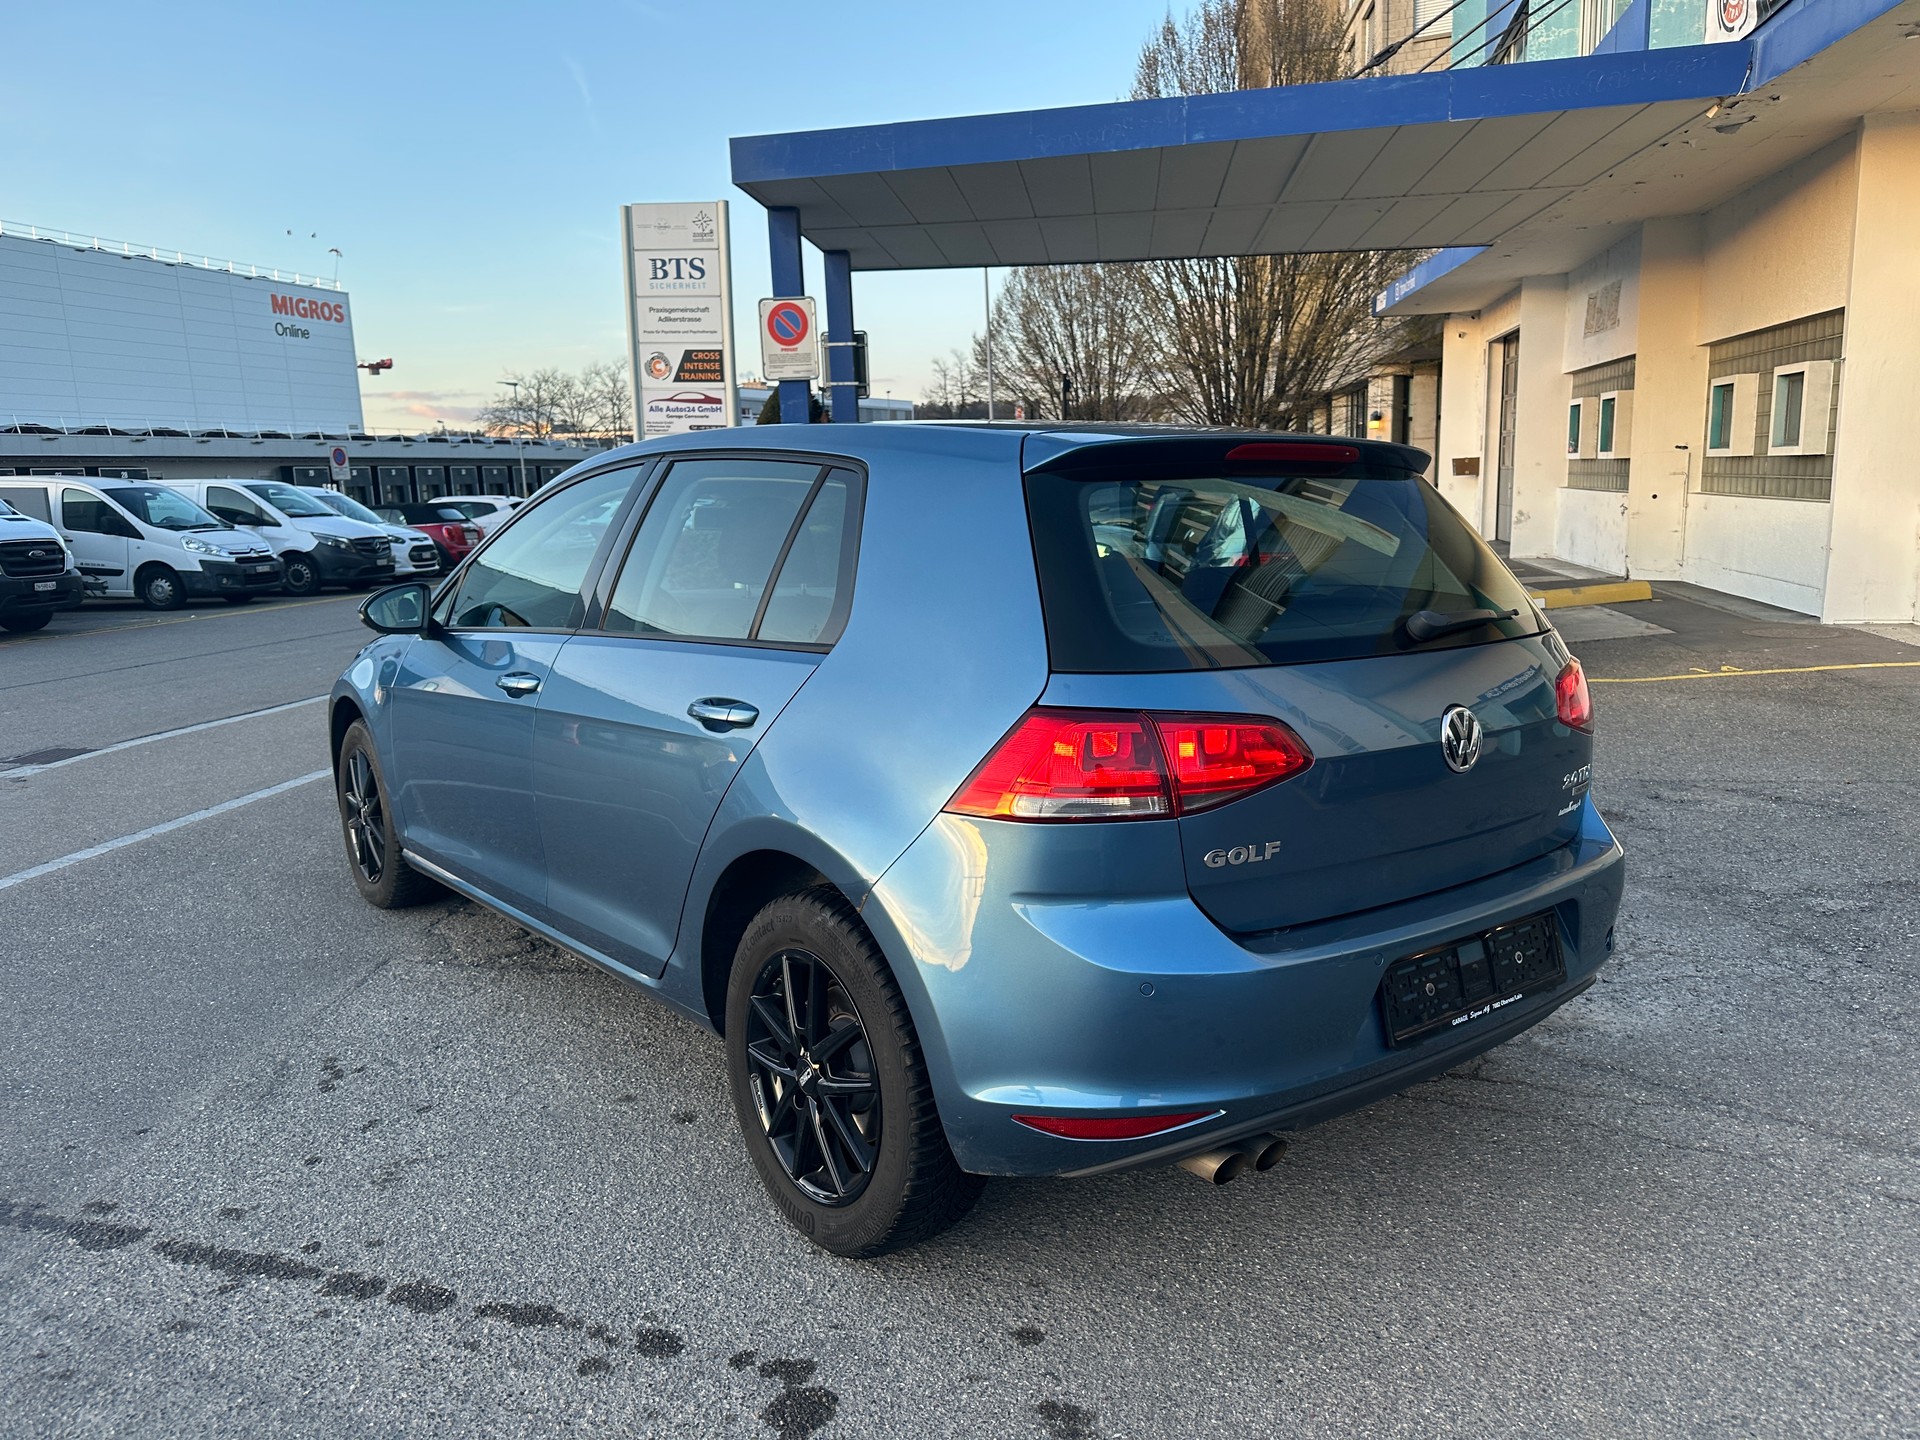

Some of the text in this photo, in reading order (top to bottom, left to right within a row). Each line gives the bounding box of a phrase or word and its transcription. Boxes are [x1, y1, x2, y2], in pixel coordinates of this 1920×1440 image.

[648, 257, 706, 280] BTS
[649, 282, 706, 290] SICHERHEIT
[270, 293, 345, 324] MIGROS
[649, 306, 710, 314] Praxisgemeinschaft
[274, 321, 310, 339] Online
[691, 352, 720, 360] CROSS
[683, 362, 721, 370] INTENSE
[679, 372, 721, 380] TRAINING
[665, 405, 696, 413] Autos24
[1203, 841, 1280, 868] GOLF
